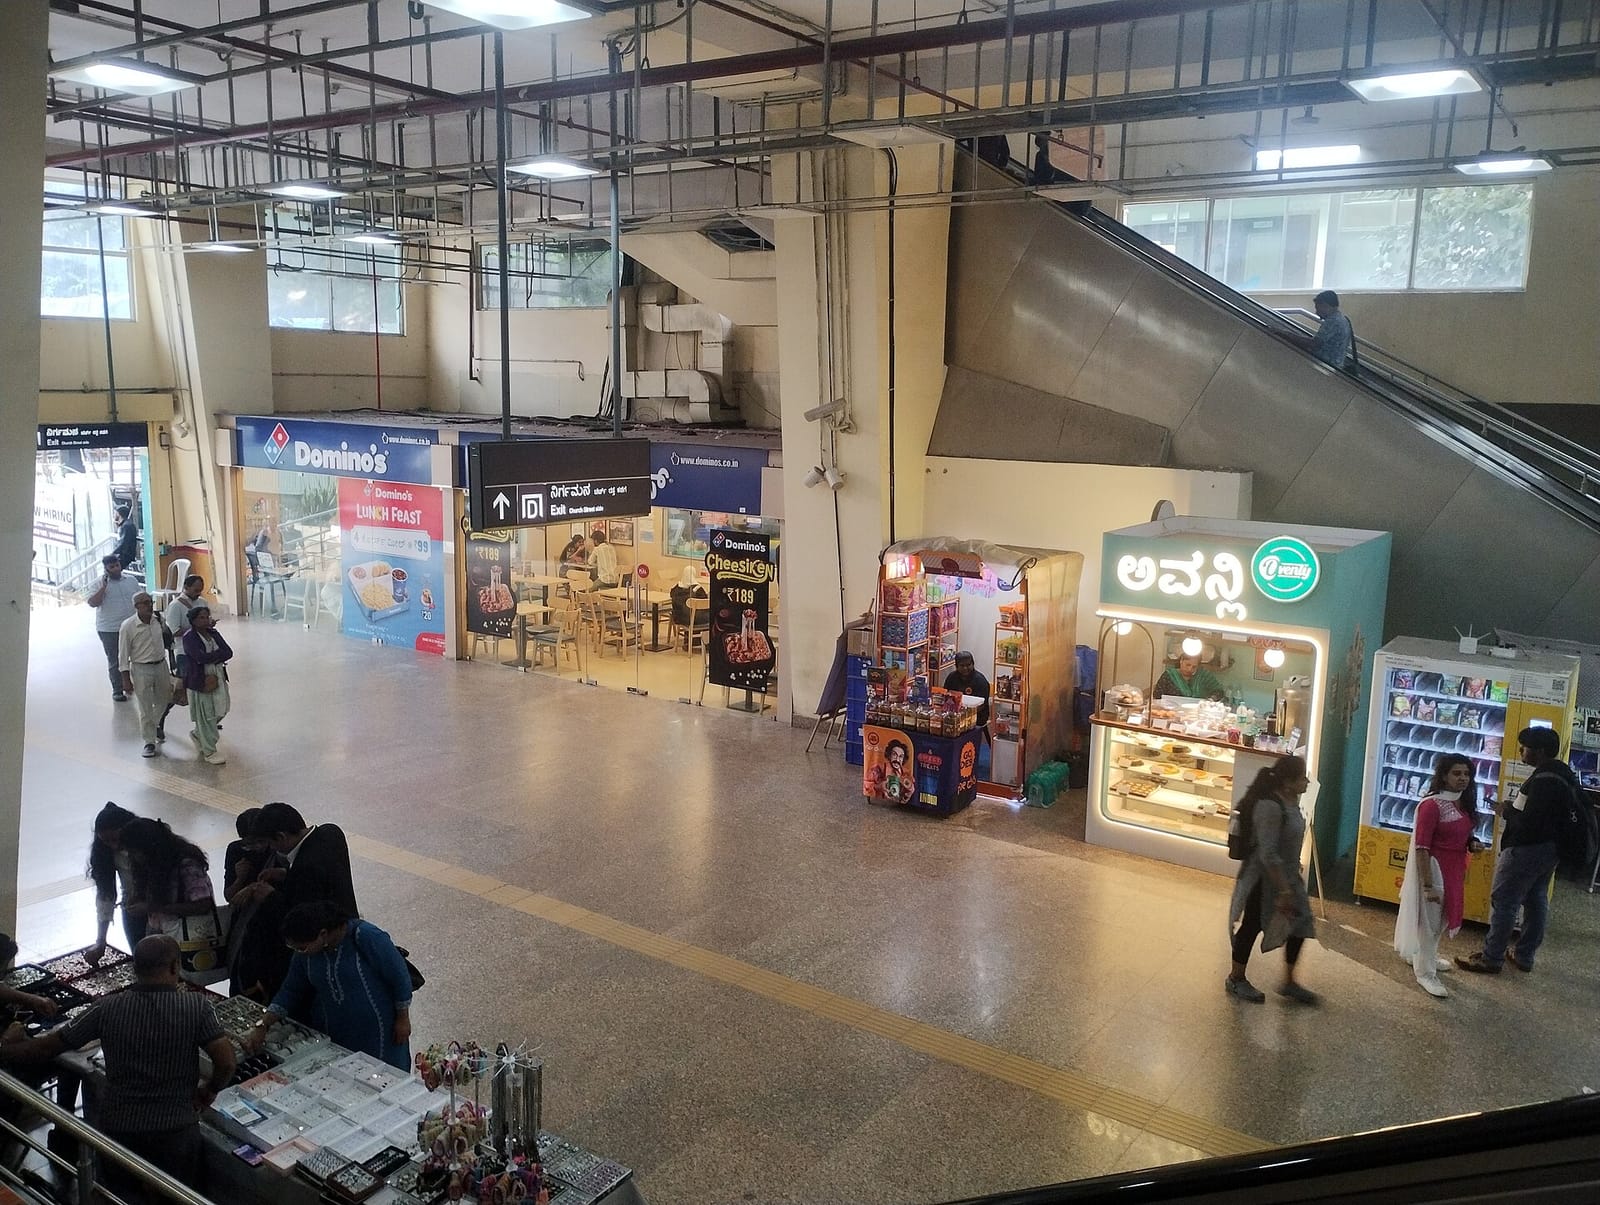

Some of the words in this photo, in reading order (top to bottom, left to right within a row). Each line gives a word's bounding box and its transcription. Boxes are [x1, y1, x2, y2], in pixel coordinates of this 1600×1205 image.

[294, 440, 388, 474] Domino's
[680, 456, 738, 468] www.dominos.co.in
[375, 488, 413, 501] Domino's
[550, 483, 591, 499] ನಿರ್ಗಮನ
[43, 508, 72, 523] HIRING
[550, 504, 566, 516] Exit
[725, 538, 767, 553] Domino's
[727, 587, 754, 604] ₹189
